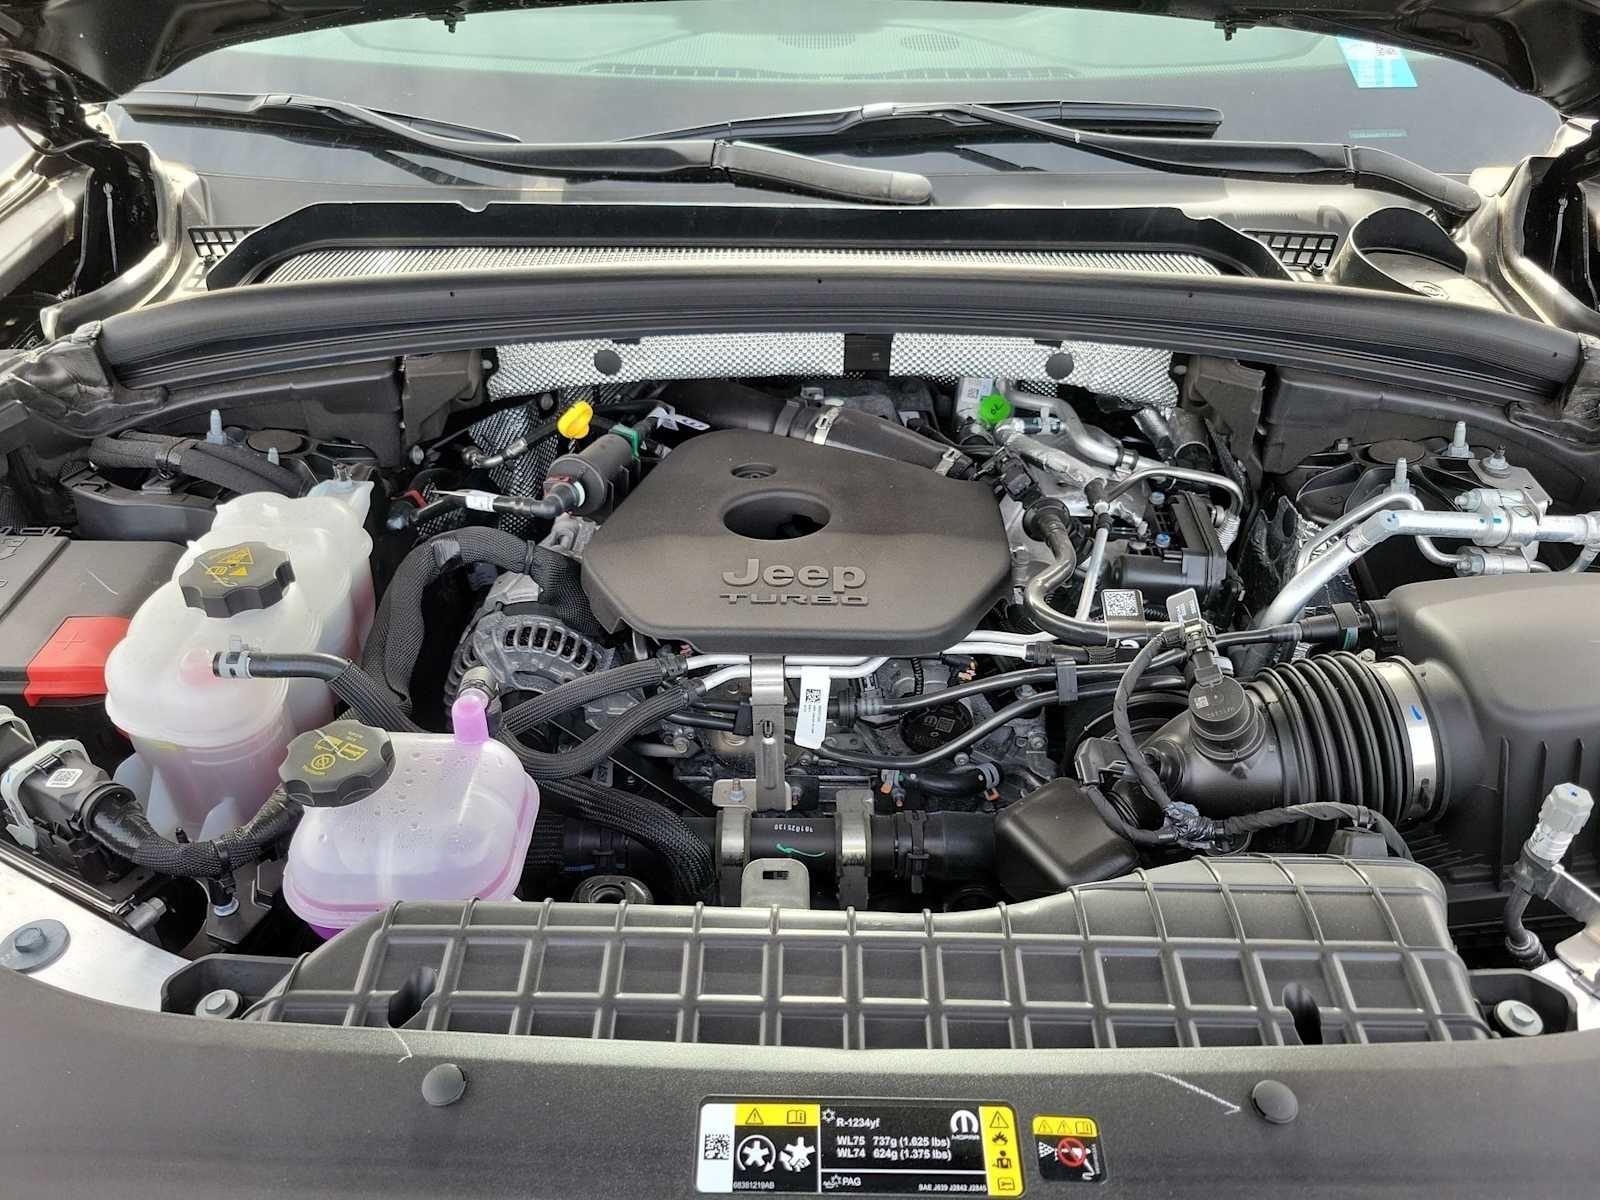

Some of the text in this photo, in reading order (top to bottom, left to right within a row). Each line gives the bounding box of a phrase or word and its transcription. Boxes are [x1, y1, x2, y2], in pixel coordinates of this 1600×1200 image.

[722, 558, 867, 594] Jeep
[720, 594, 869, 606] TURBO
[836, 1117, 881, 1130] R-1234yf
[836, 1135, 951, 1149] WL75 737g (1.625 lbs)
[836, 1147, 866, 1158] WL74
[873, 1148, 898, 1161] 624g
[932, 1148, 952, 1162] lbs)
[842, 1177, 862, 1187] PAG
